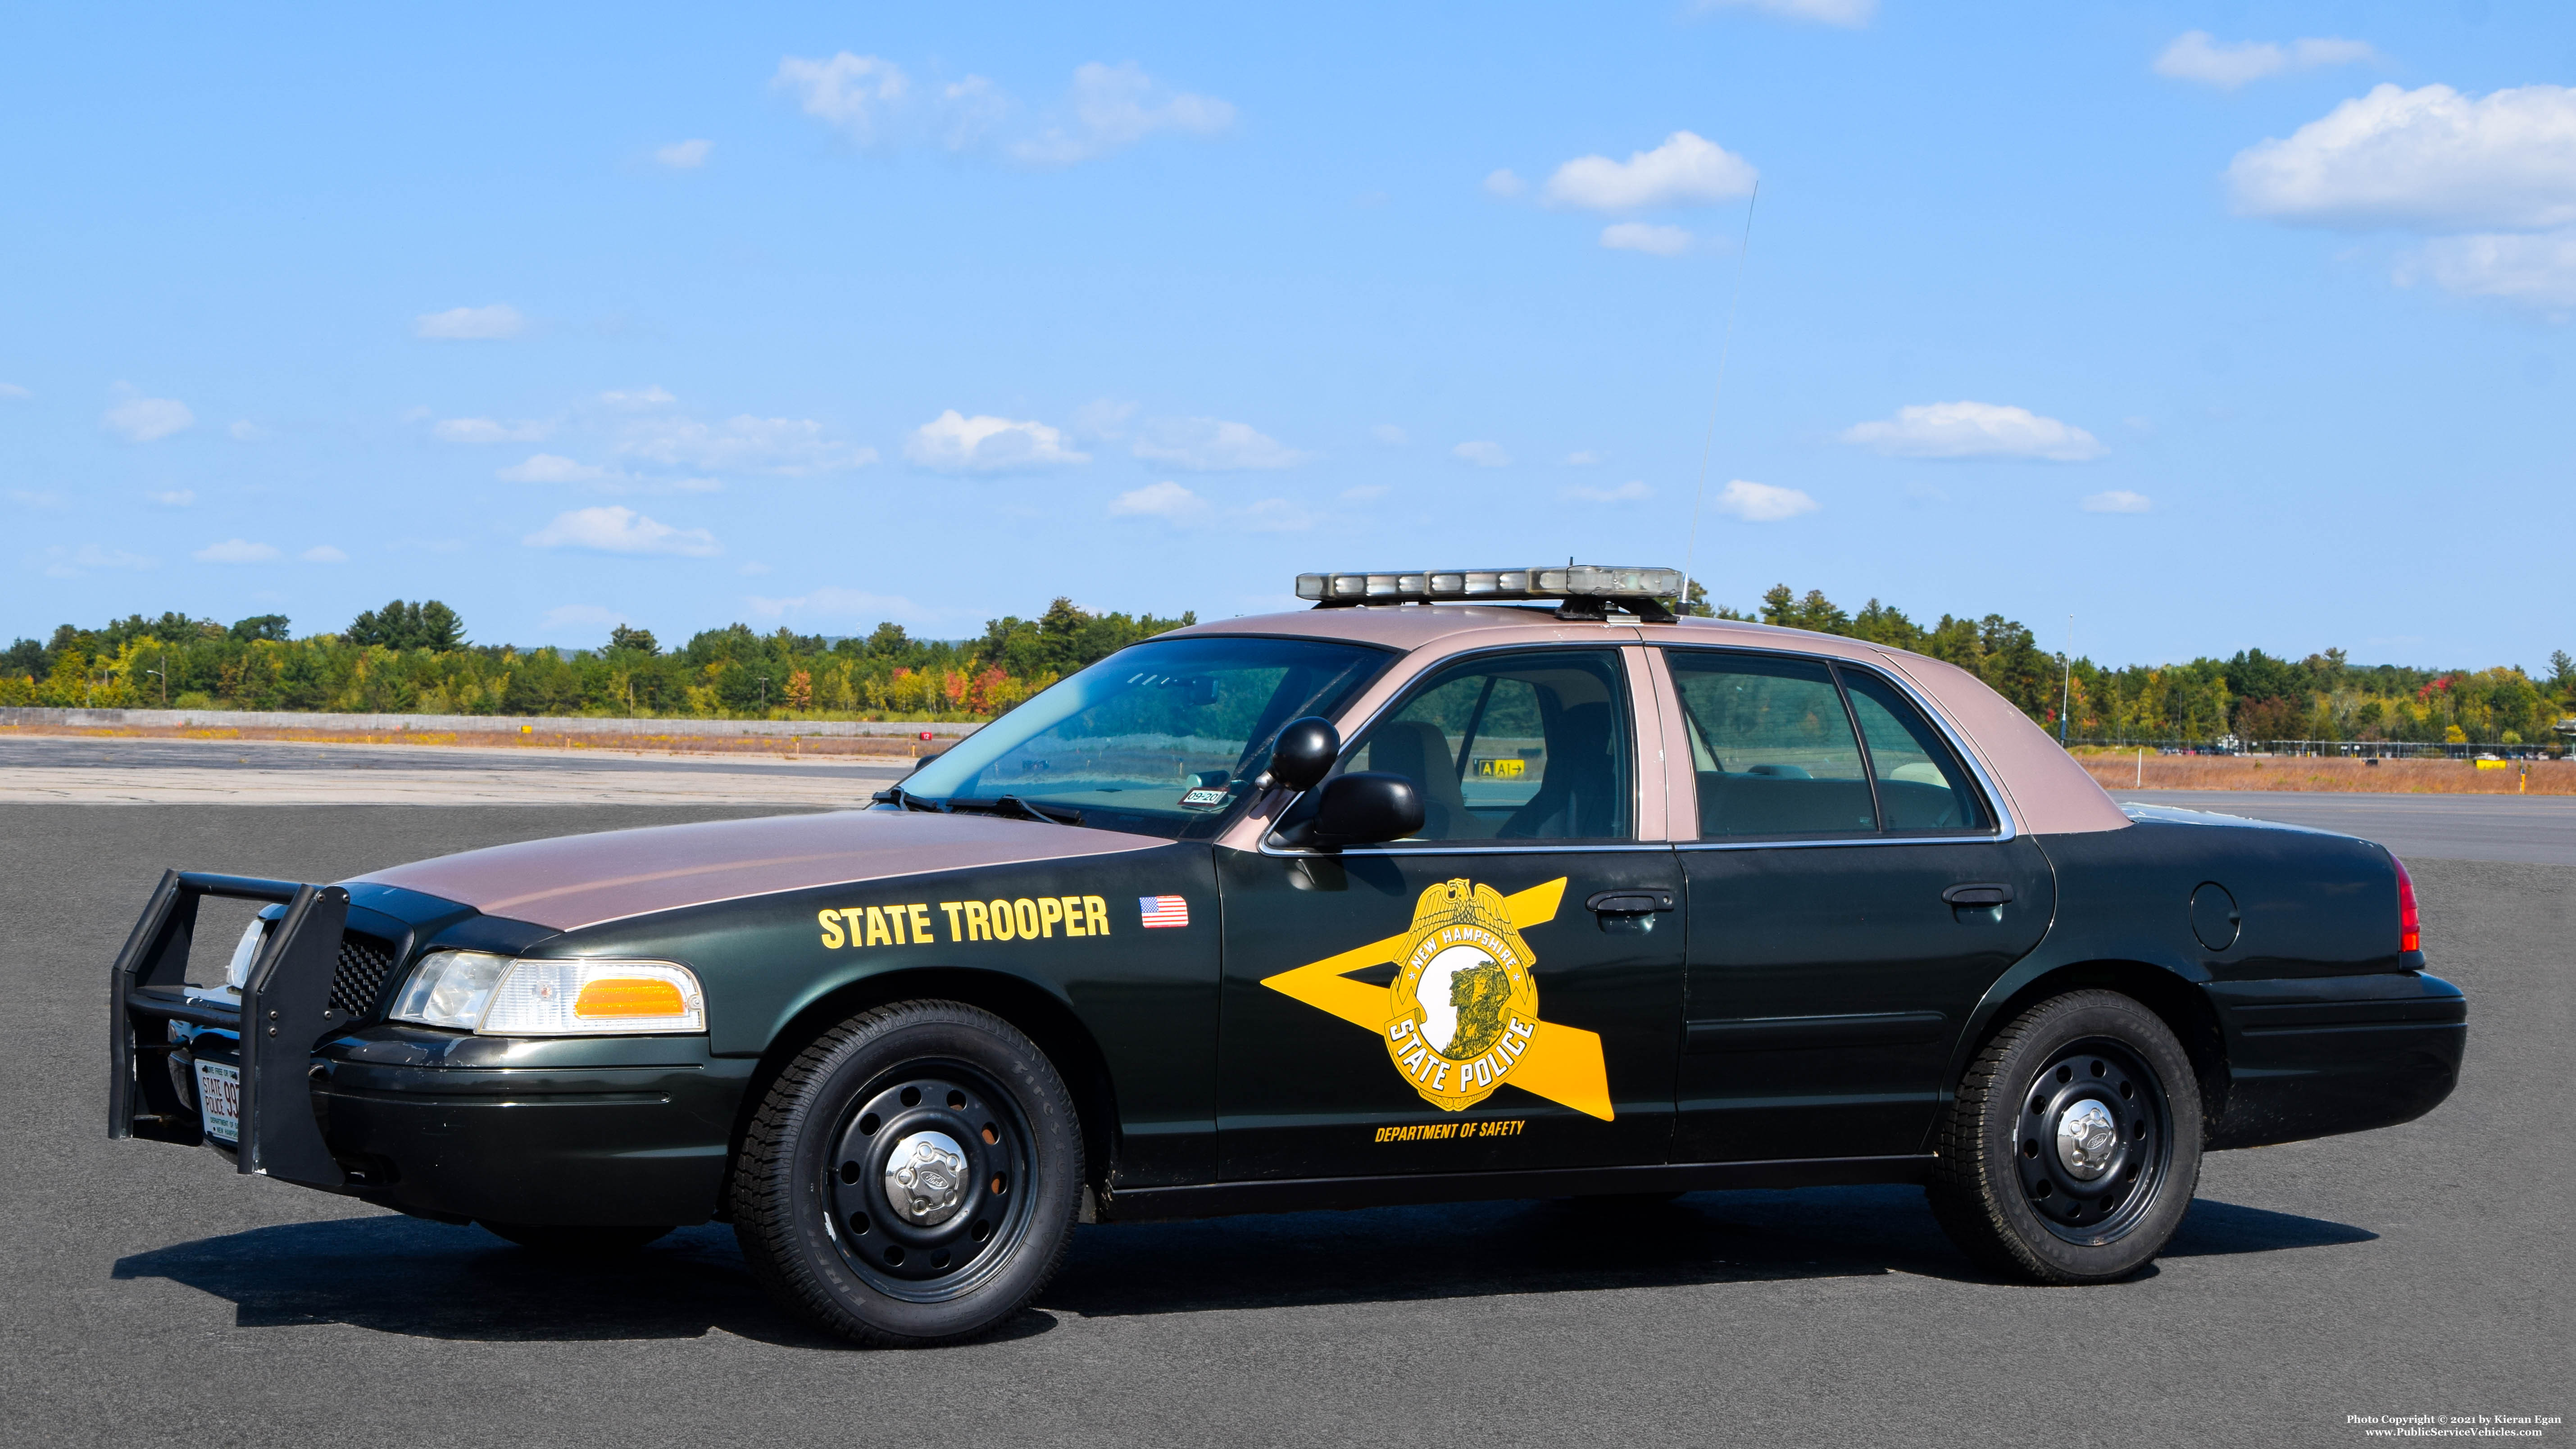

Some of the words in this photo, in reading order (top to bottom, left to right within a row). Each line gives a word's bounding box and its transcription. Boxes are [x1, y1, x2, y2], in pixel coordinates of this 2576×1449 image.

[1483, 762, 1491, 775] A
[1187, 792, 1218, 801] 09-20
[818, 903, 934, 949] STATE
[940, 895, 1110, 942] TROOPER
[1410, 937, 1437, 970] NEW
[1442, 927, 1517, 970] HAMPSHIRE
[1389, 1018, 1450, 1091] STATE
[1460, 1017, 1534, 1092] POLICE
[203, 1077, 222, 1096] STATE
[205, 1095, 225, 1116] POLICE
[1375, 1123, 1459, 1142] DEPARTMENT
[1460, 1122, 1478, 1138] OF
[1479, 1120, 1525, 1137] SAFETY
